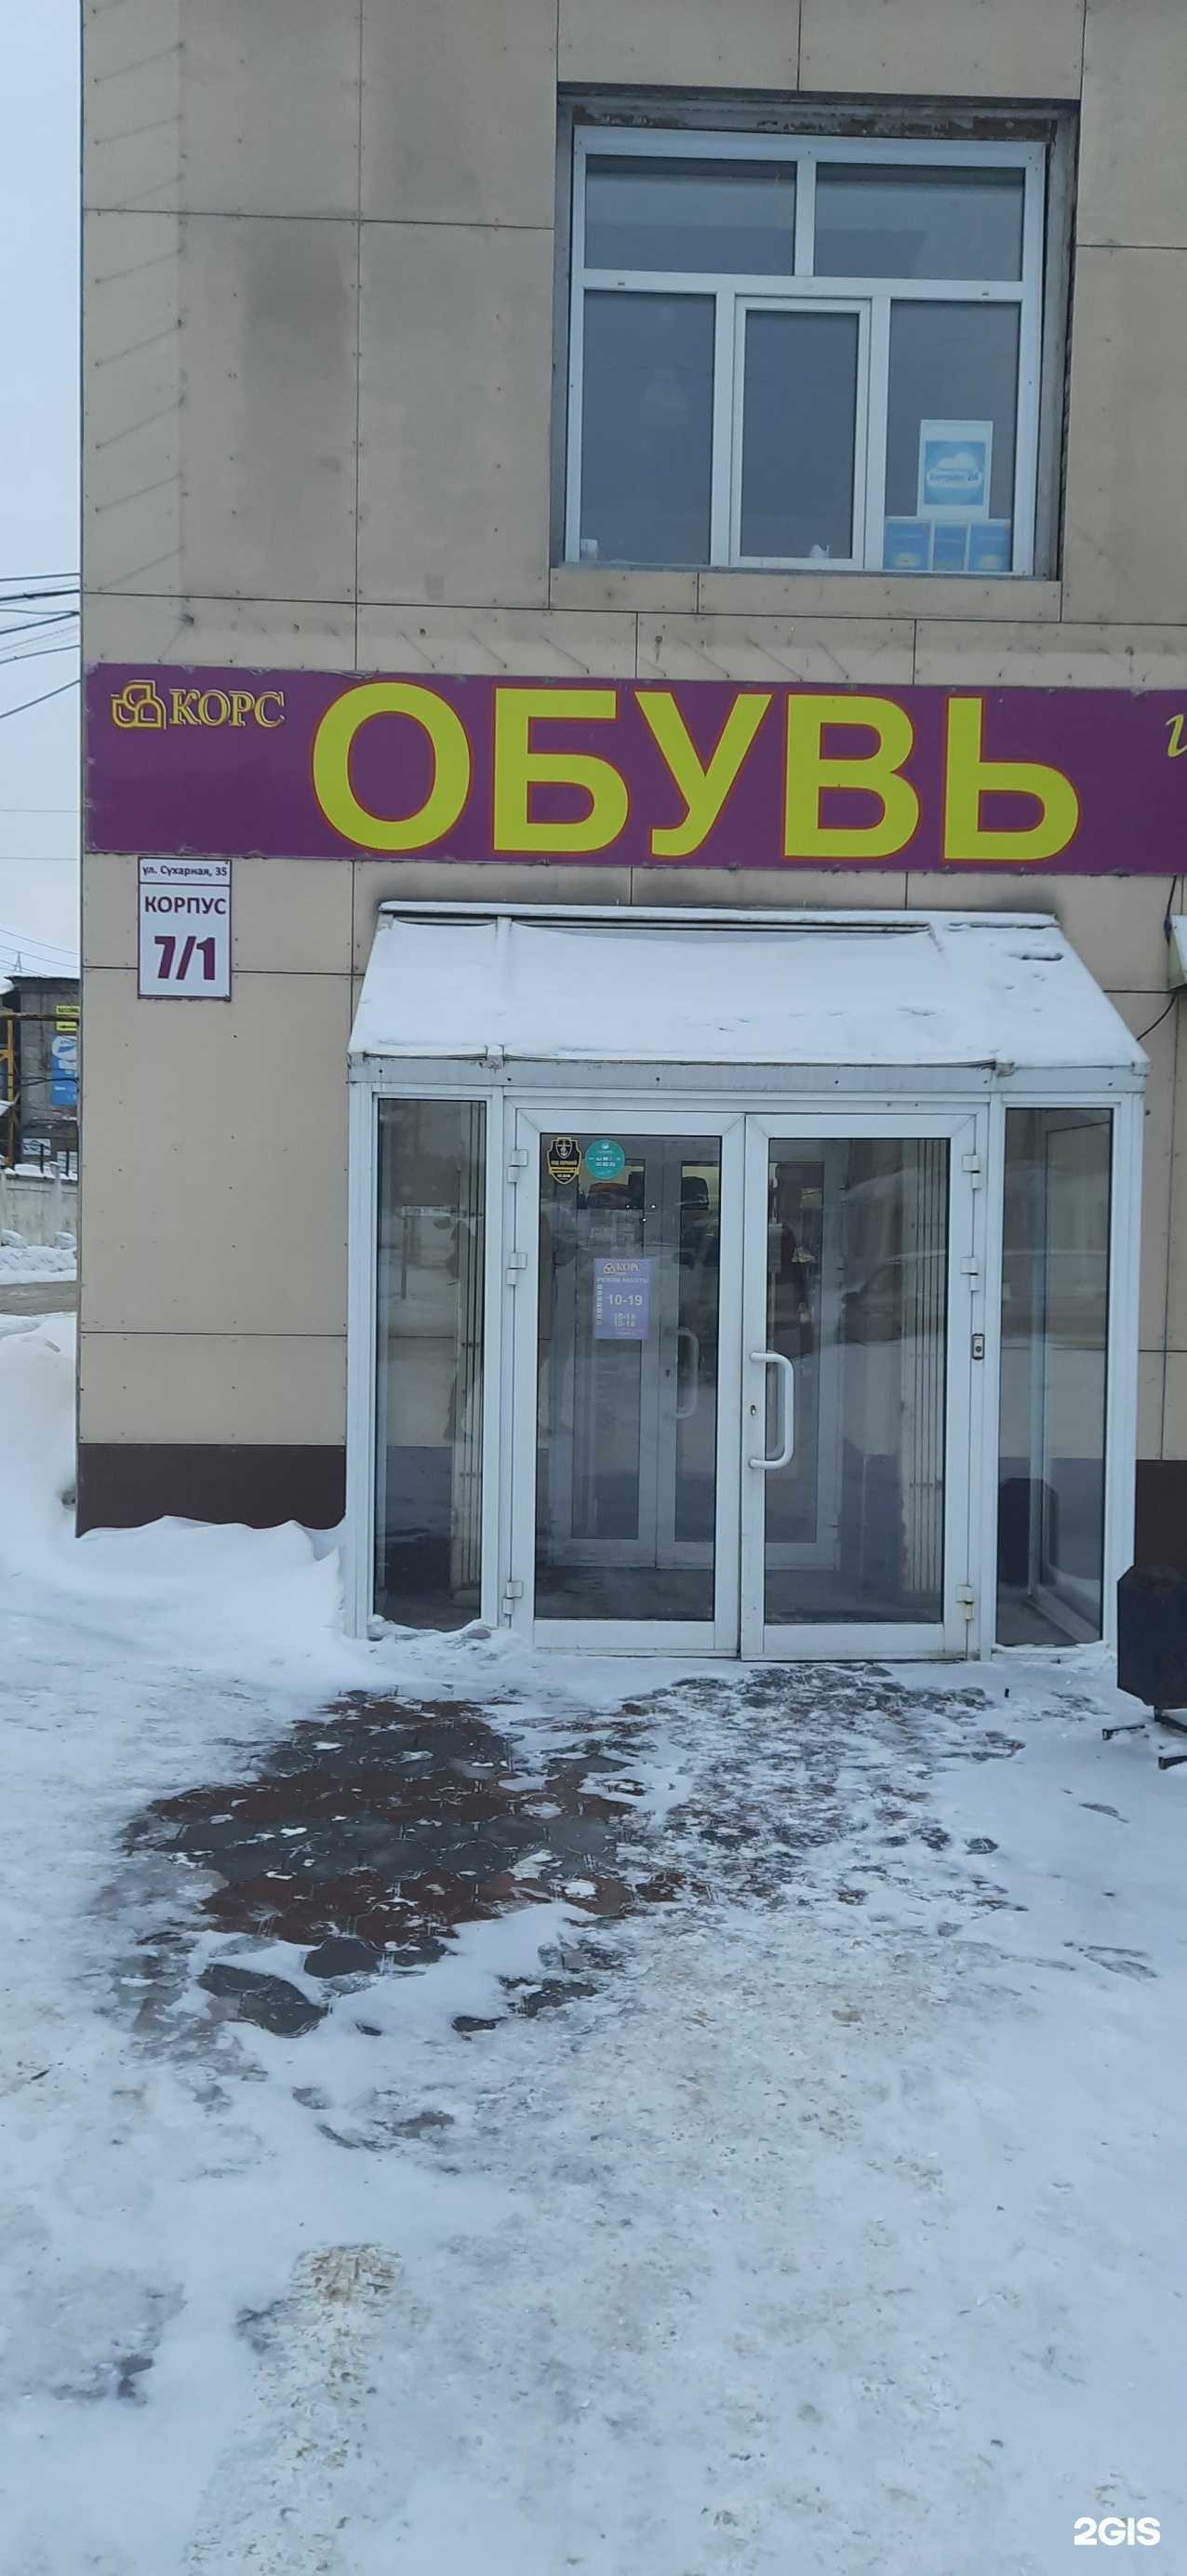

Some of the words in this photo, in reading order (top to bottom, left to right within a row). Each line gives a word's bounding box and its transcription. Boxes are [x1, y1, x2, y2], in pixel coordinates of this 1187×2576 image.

[168, 689, 285, 728] КОРС
[312, 680, 1081, 861] ОБУВЬ
[142, 865, 157, 876] ул.
[160, 865, 213, 877] Сухарная,
[215, 866, 228, 877] 35
[144, 895, 227, 915] КОРПУС
[153, 935, 216, 981] 7/1
[608, 1294, 643, 1307] 10-19
